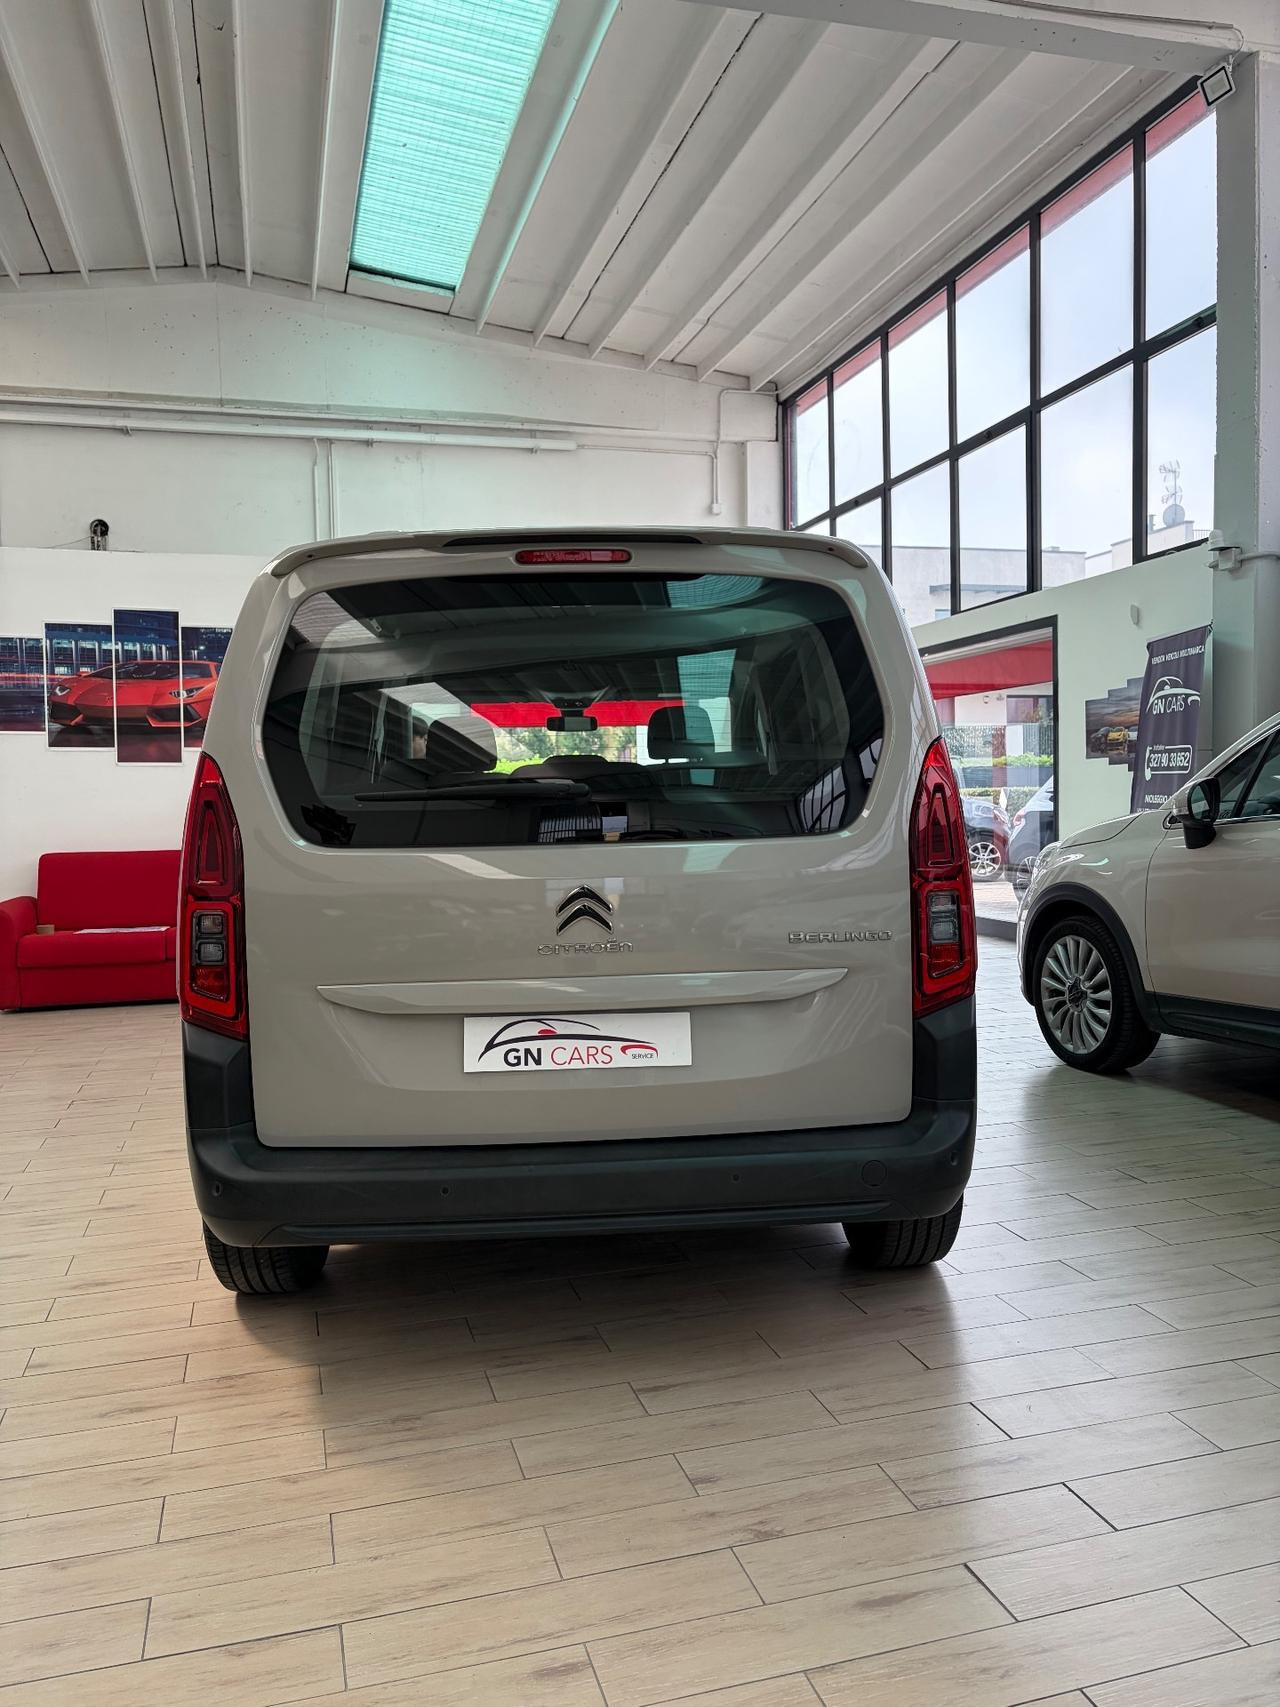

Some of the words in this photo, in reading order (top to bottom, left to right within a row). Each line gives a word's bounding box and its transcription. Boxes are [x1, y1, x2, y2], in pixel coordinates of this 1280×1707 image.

[1152, 698, 1165, 715] GN
[1166, 694, 1185, 713] CARS
[788, 930, 893, 944] BERLINGO
[503, 1047, 542, 1067] GN
[550, 1045, 613, 1066] CARS
[631, 1052, 655, 1060] SERVICE
